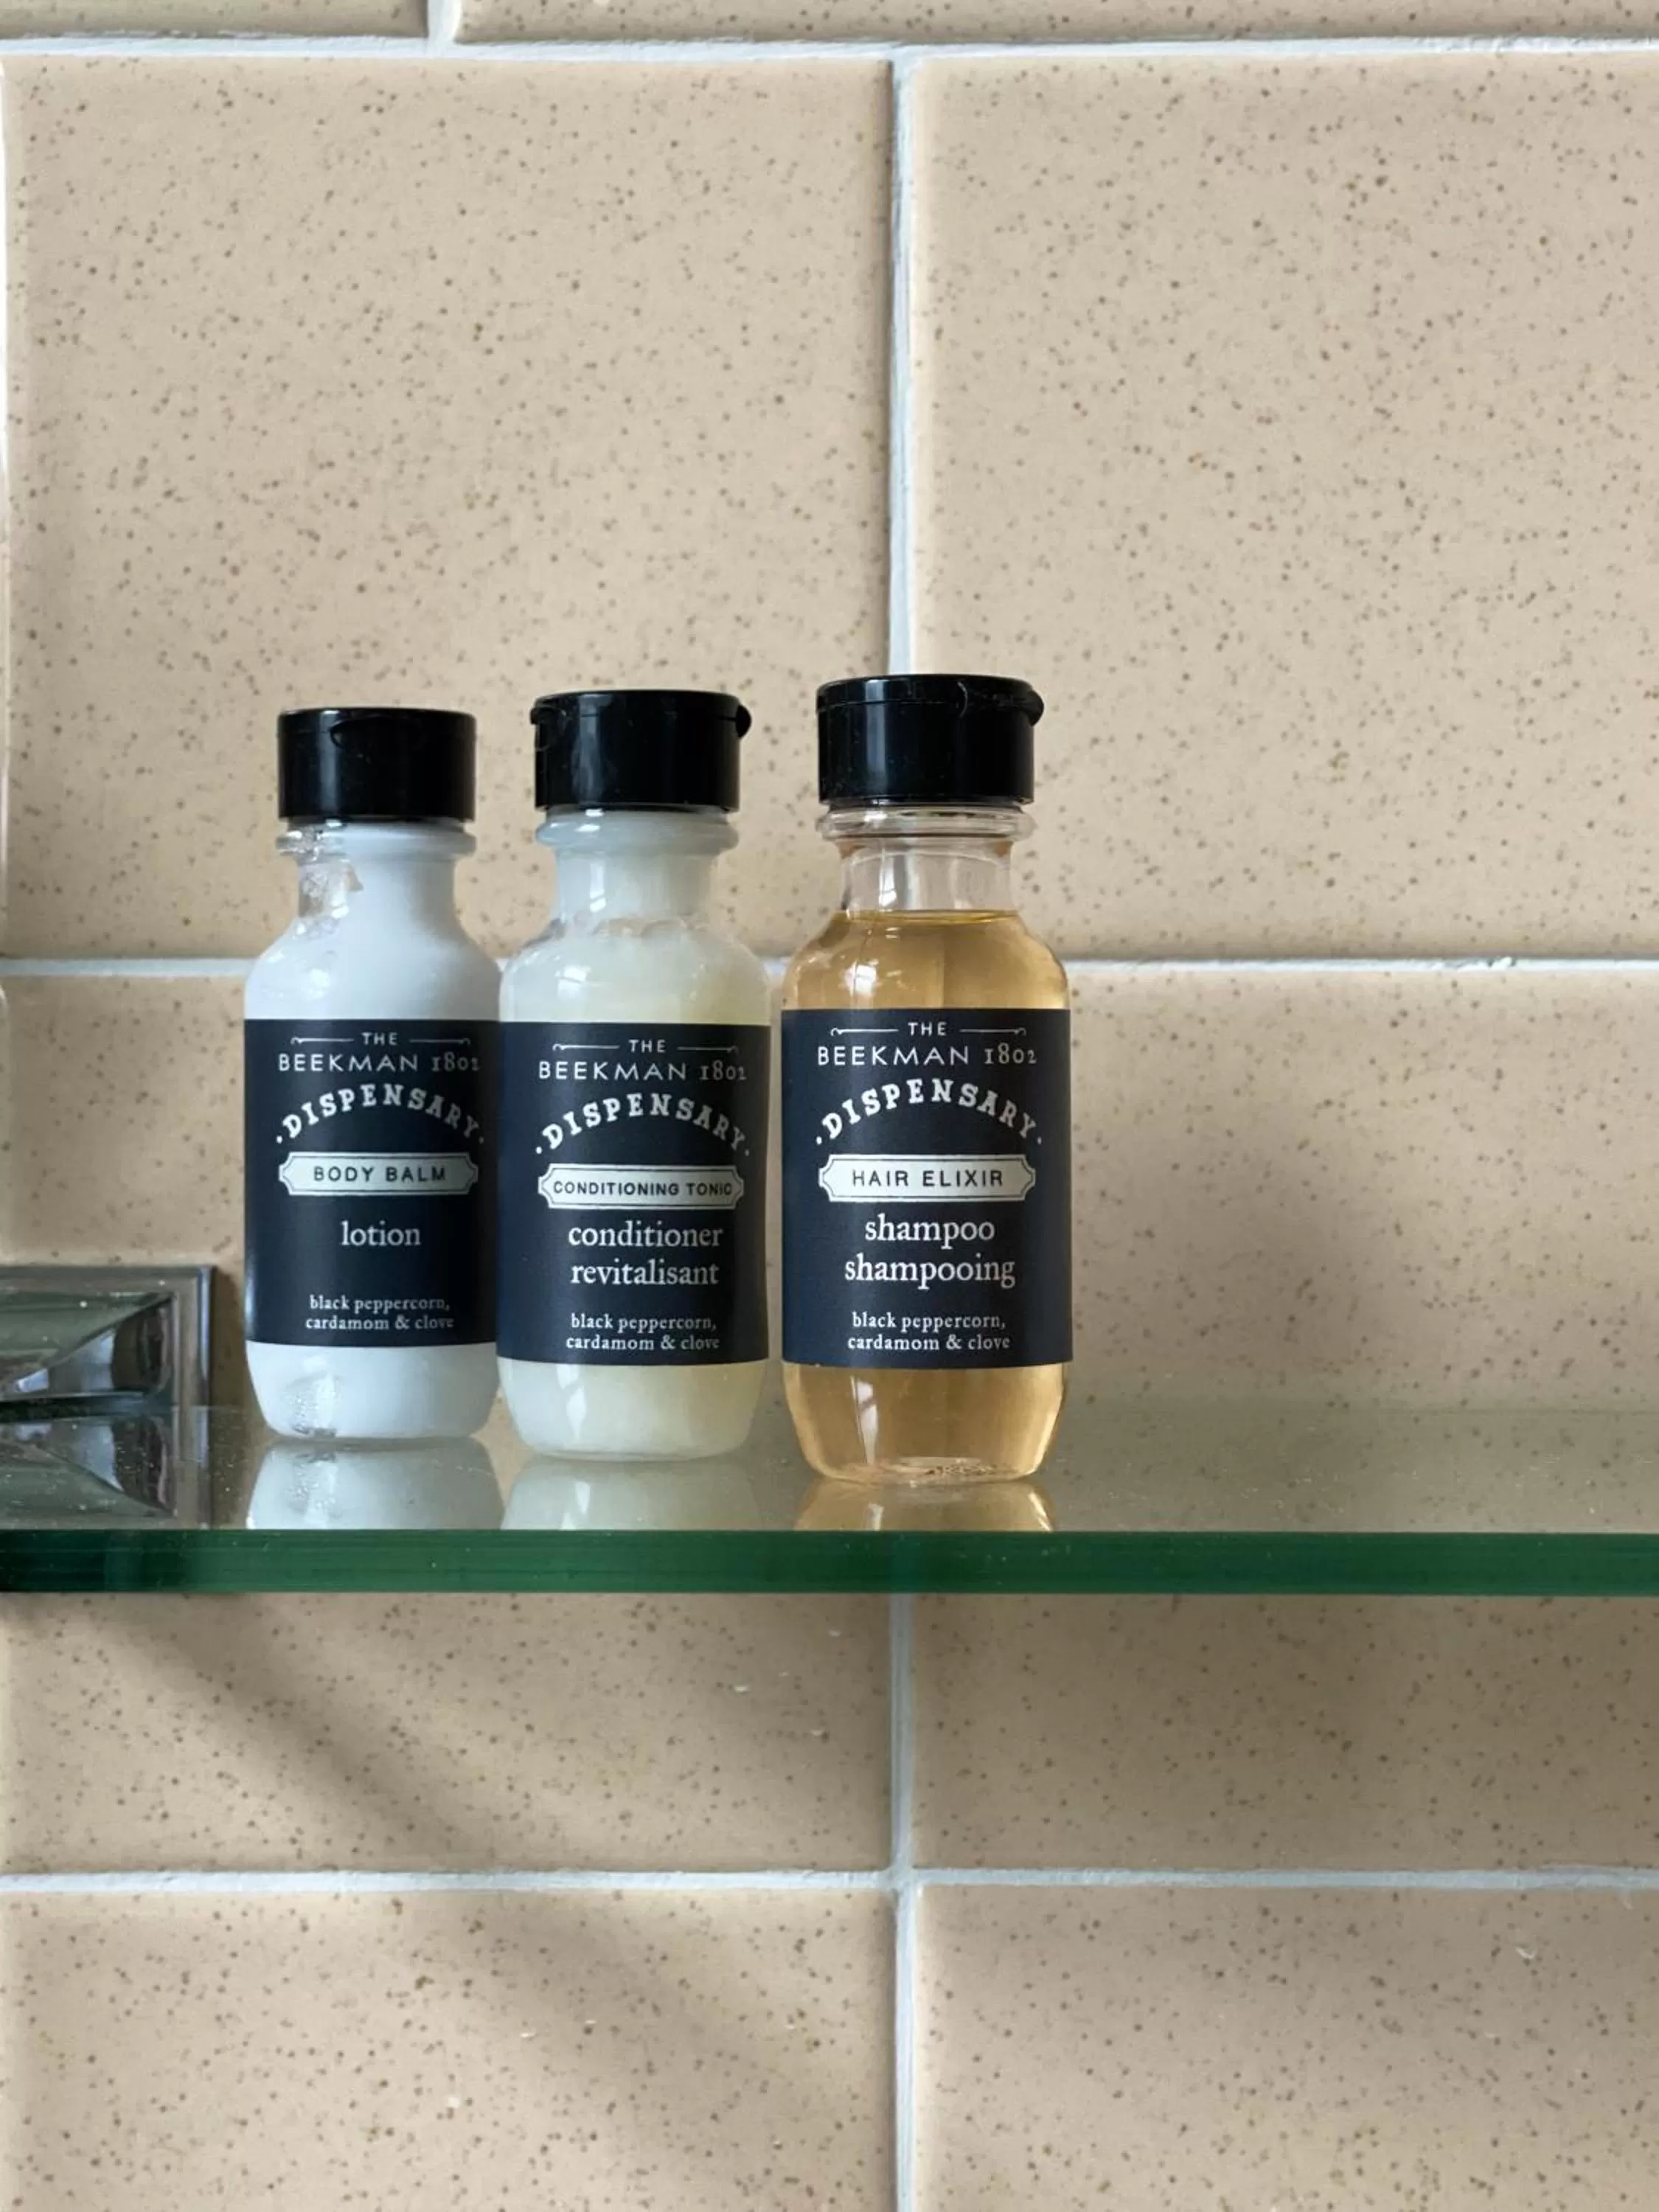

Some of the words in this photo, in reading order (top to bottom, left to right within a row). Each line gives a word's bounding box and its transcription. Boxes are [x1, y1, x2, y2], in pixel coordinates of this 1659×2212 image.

[908, 1022, 947, 1036] THE
[363, 1032, 397, 1046] THE
[629, 1039, 667, 1053] THE
[279, 1054, 418, 1071] BEEKMAN
[818, 1046, 969, 1066] BEEKMAN
[983, 1043, 1037, 1065] 1802
[538, 1061, 686, 1080] BEEKMAN
[313, 1166, 374, 1182] BODY
[386, 1166, 445, 1182] BALM
[852, 1170, 909, 1186] HAIR
[922, 1170, 1004, 1187] ELIXIR
[553, 1180, 679, 1196] CONDITIONING
[686, 1181, 733, 1196] TONIC
[341, 1220, 420, 1246] lotion
[568, 1220, 723, 1247] conditioner
[865, 1213, 995, 1250] shampoo
[570, 1258, 720, 1285] revitalisant
[844, 1253, 1016, 1290] shampooing
[310, 1295, 350, 1310] black
[355, 1295, 451, 1314] peppercorn,
[306, 1315, 389, 1329] cardamom
[395, 1316, 411, 1329] &
[414, 1315, 455, 1329] clove
[571, 1312, 613, 1329] black
[618, 1315, 717, 1333] peppercorn,
[852, 1312, 897, 1329] black
[901, 1313, 1006, 1333] peppercorn,
[566, 1335, 654, 1350] cardamom
[661, 1336, 675, 1350] &
[681, 1335, 720, 1350] clove
[847, 1335, 939, 1351] cardamom
[945, 1335, 962, 1351] &
[968, 1335, 1010, 1351] clove
